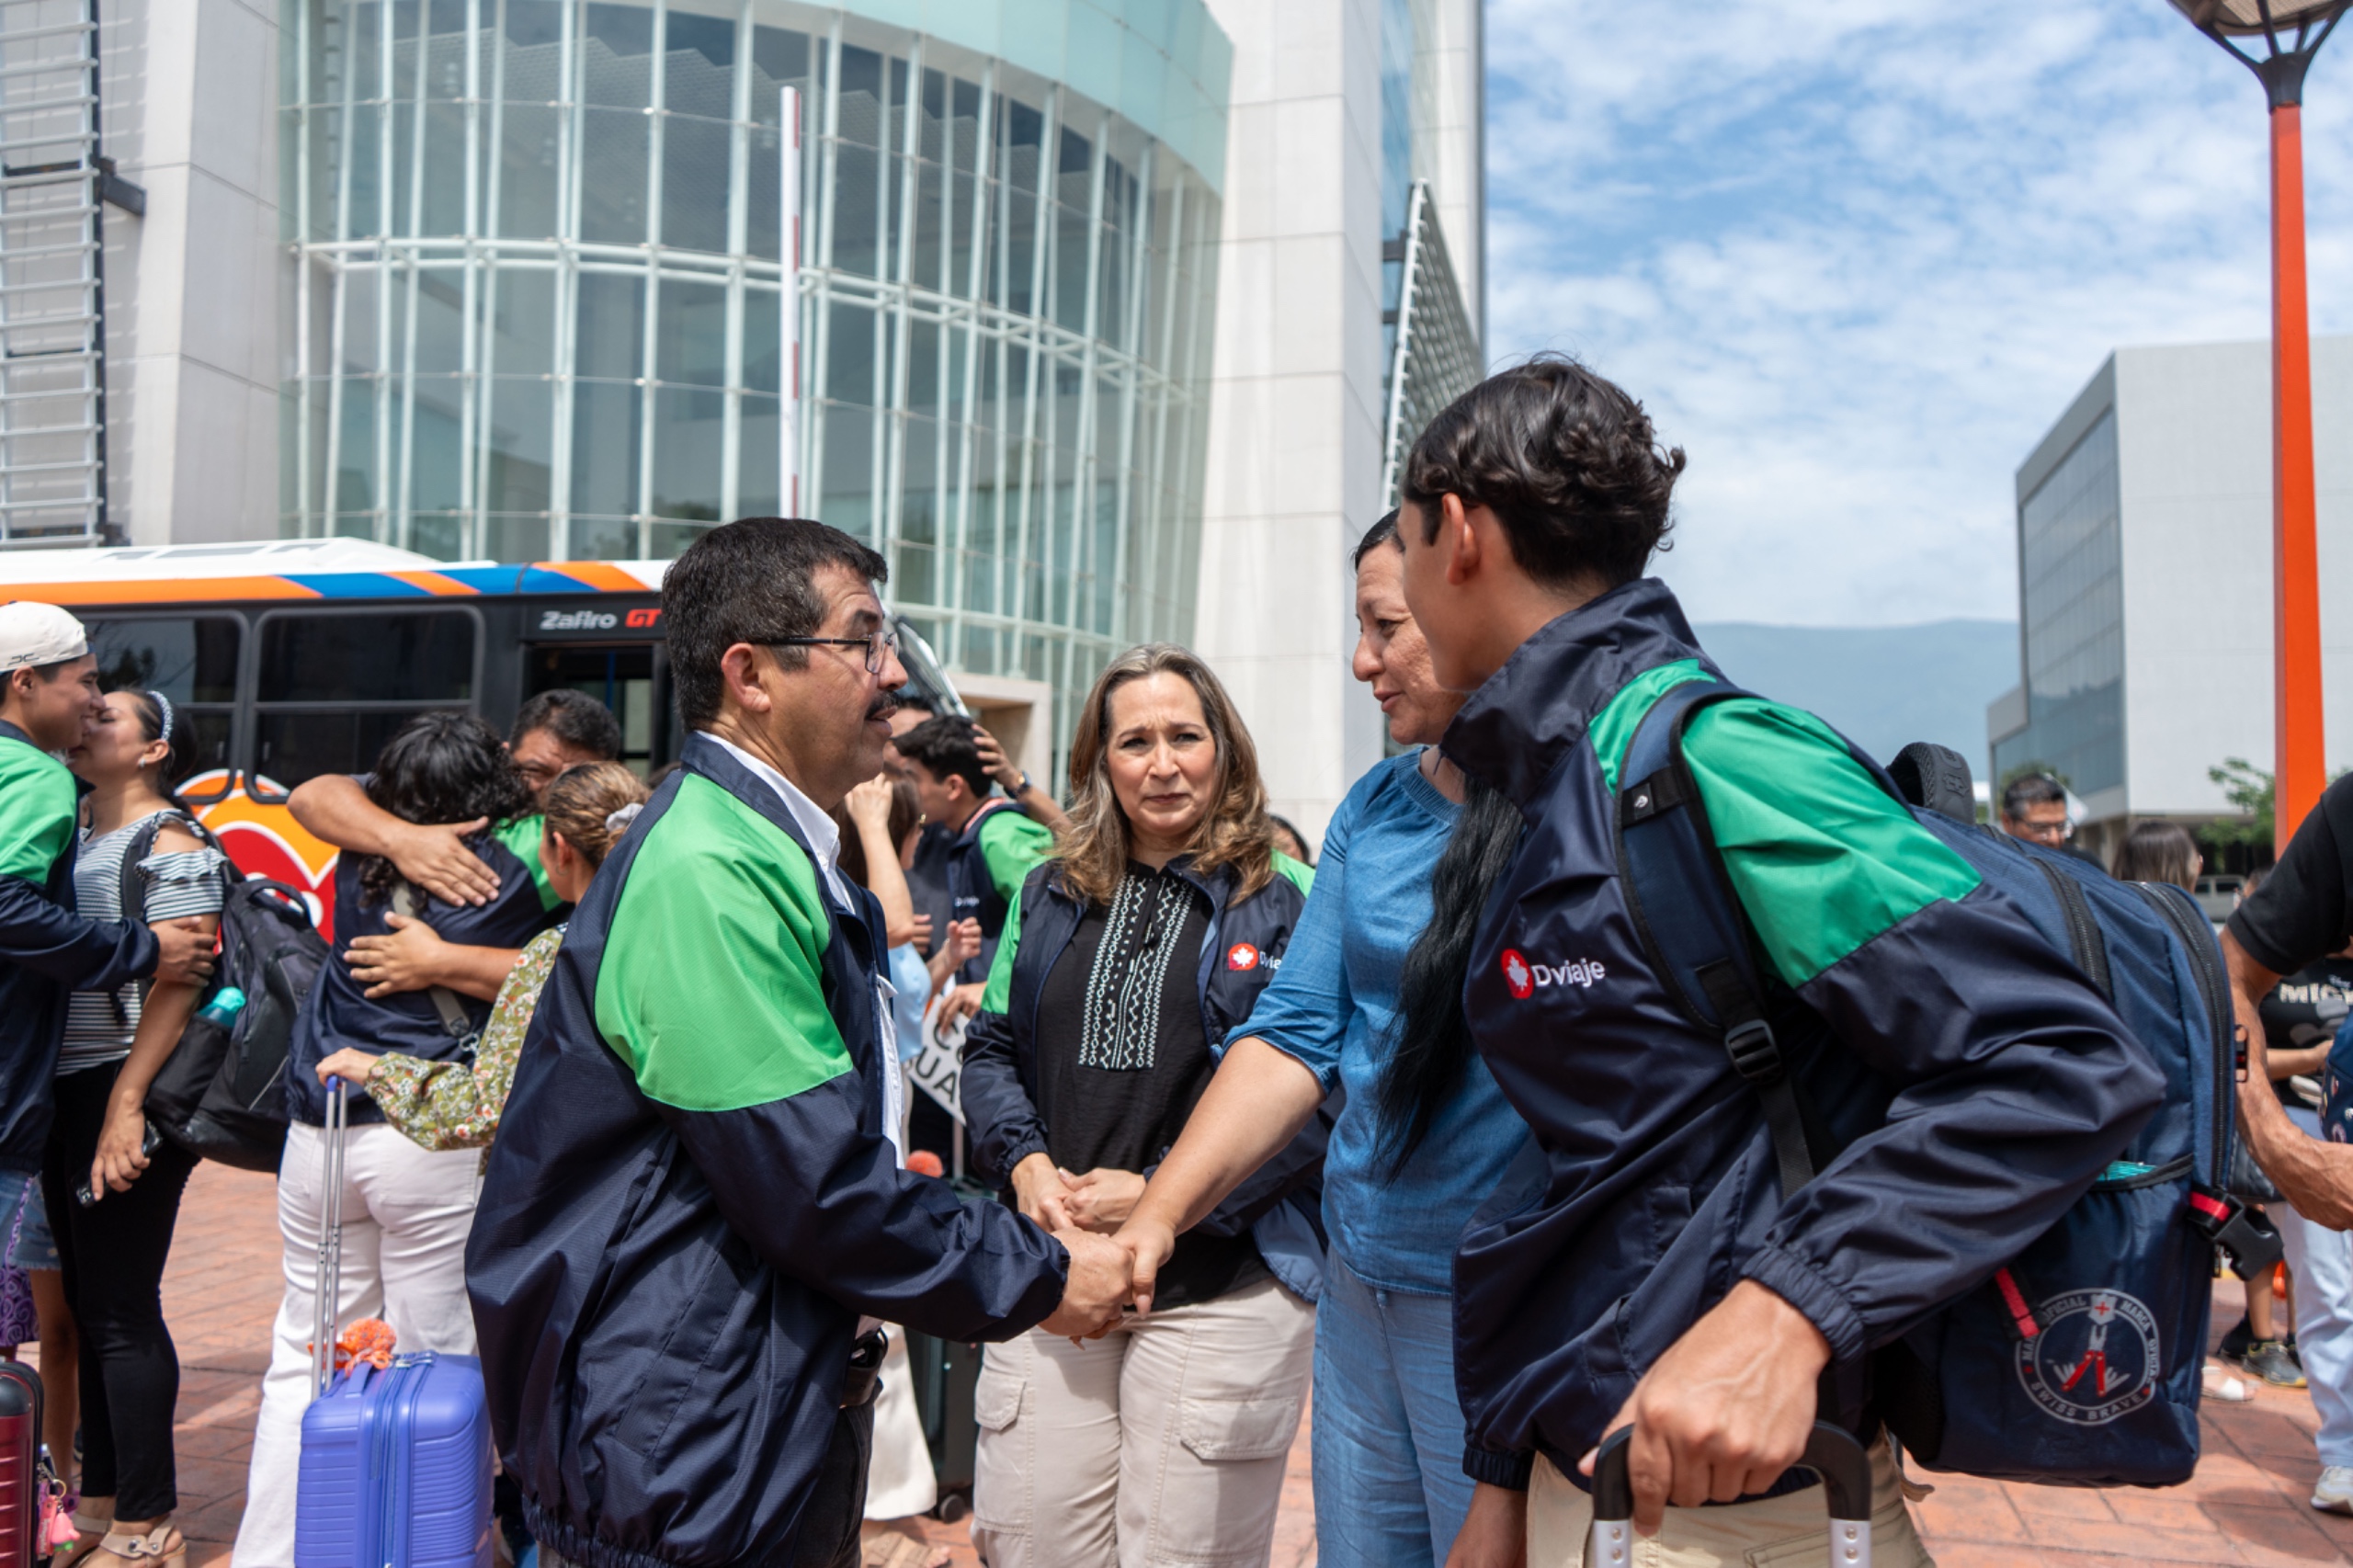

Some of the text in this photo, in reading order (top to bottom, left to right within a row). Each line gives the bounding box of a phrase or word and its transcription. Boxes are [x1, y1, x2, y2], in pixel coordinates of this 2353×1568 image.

[540, 608, 662, 630] Zafiro GT
[1531, 958, 1605, 987] Dviaje
[2120, 1300, 2152, 1333] MARCA
[2030, 1381, 2143, 1420] SWISS BRAVE
